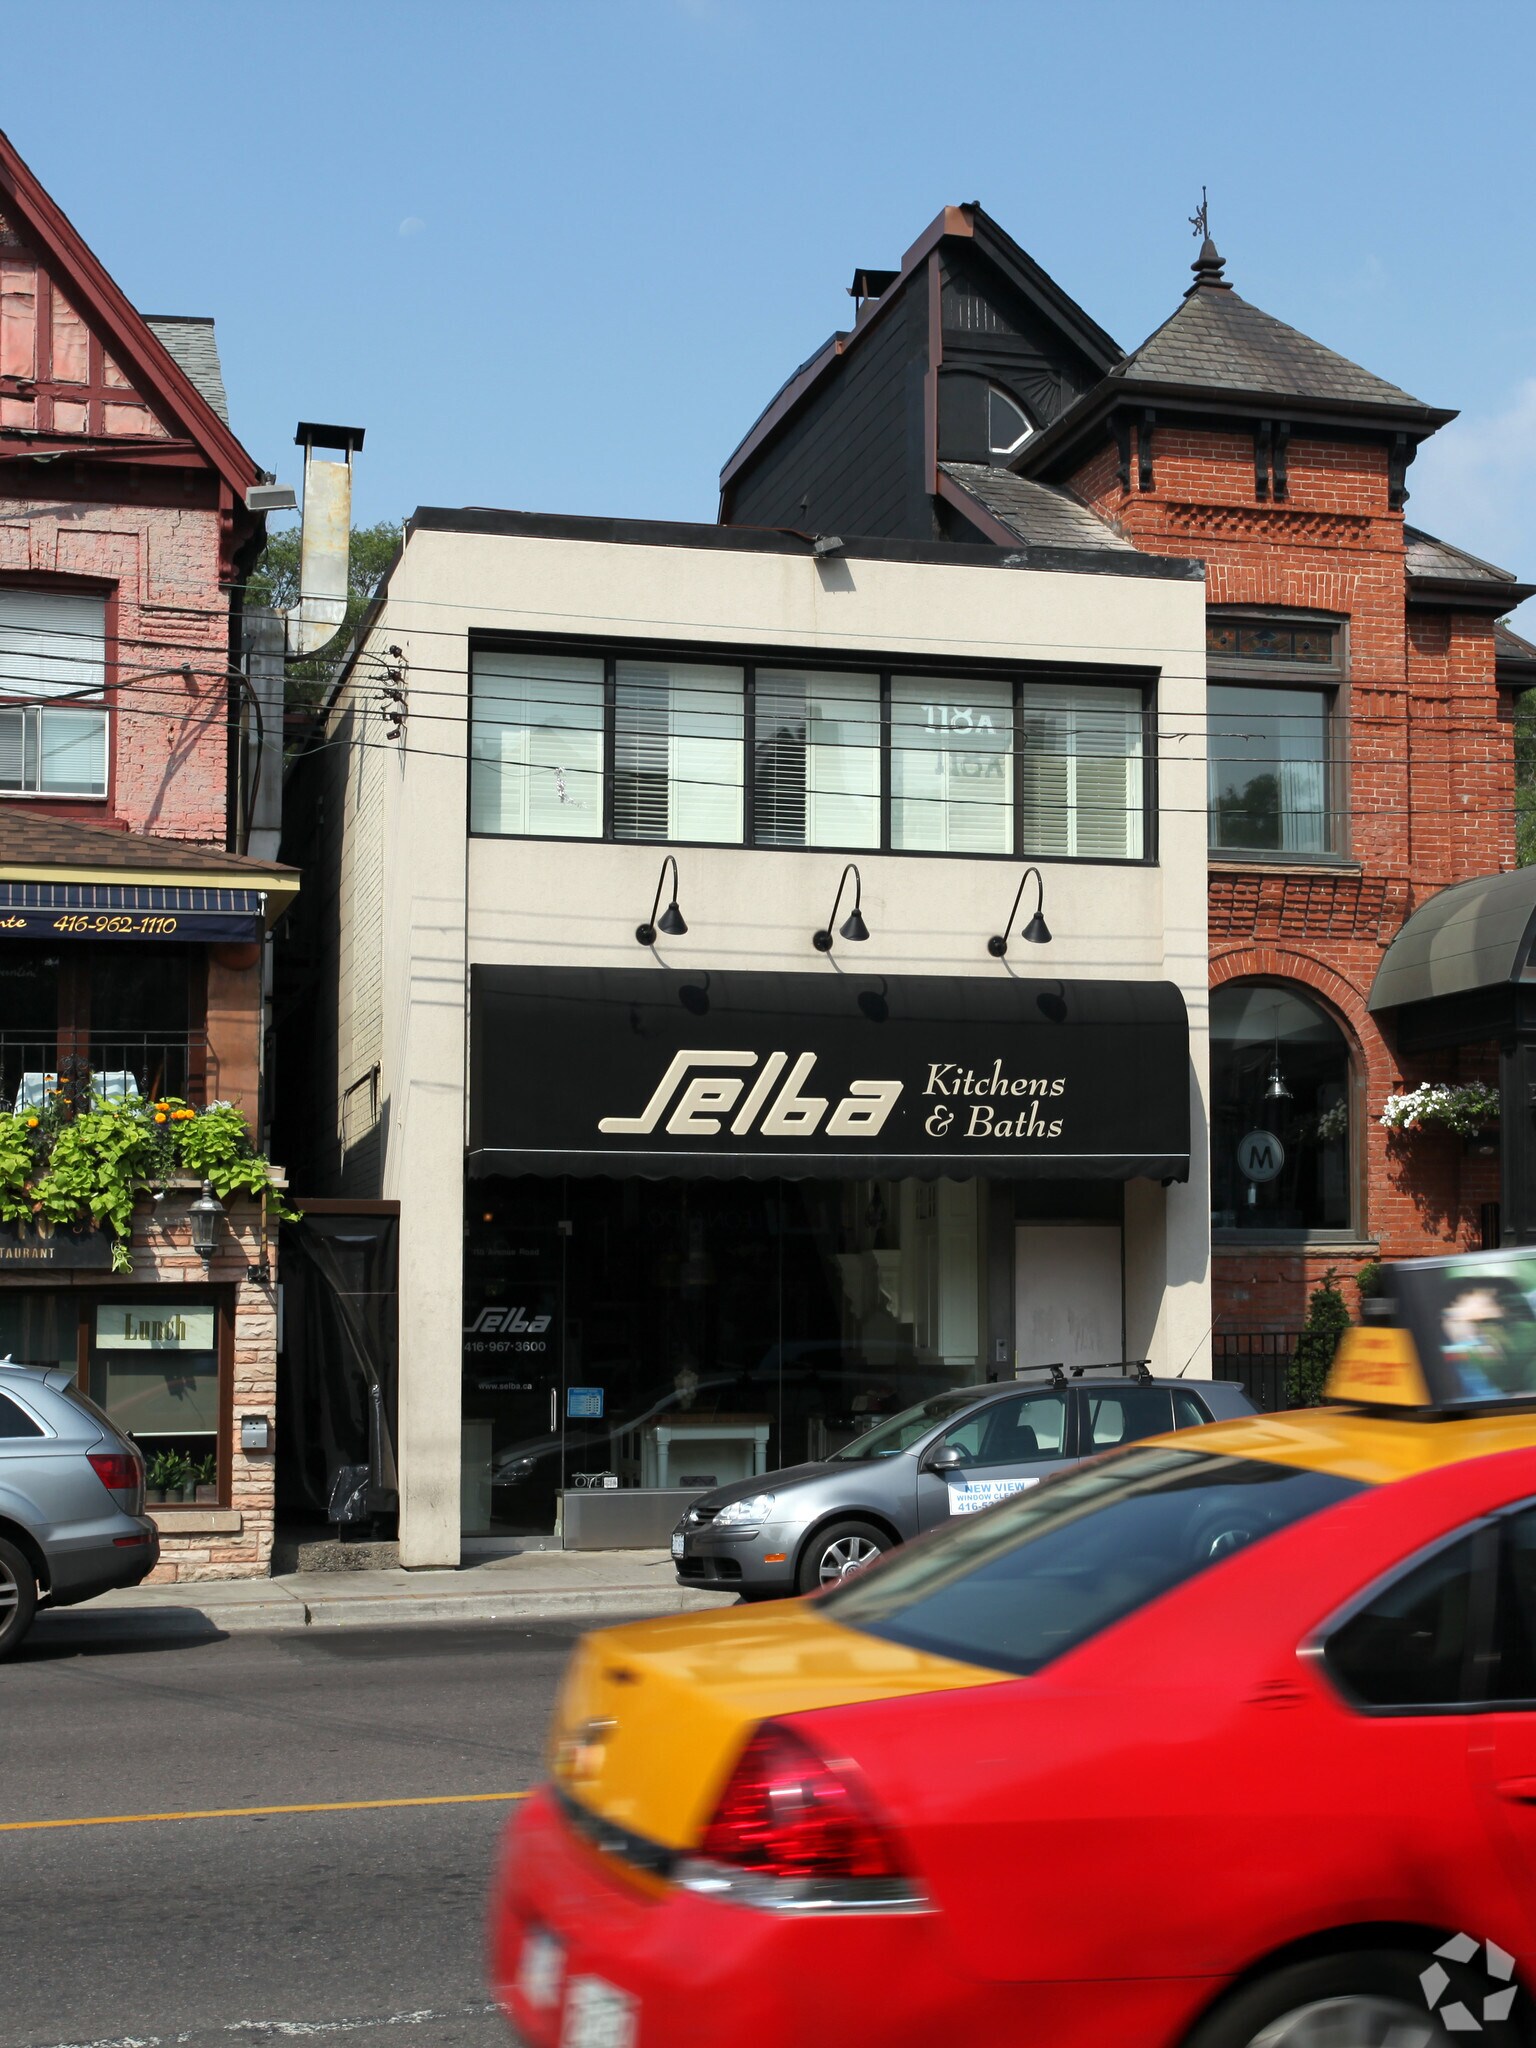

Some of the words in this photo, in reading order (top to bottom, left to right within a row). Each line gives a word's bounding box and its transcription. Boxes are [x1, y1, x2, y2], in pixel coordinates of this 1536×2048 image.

[53, 914, 177, 934] 416-962-1110
[922, 1058, 1067, 1098] Kitchens
[597, 1048, 905, 1136] Selba
[925, 1104, 956, 1138] &
[963, 1100, 1064, 1139] Baths
[1249, 1145, 1274, 1169] M
[124, 1313, 187, 1341] Lunch
[463, 1306, 552, 1333] Selba
[478, 1382, 533, 1390] www.selba.ca
[965, 1484, 992, 1493] NEW
[995, 1482, 1025, 1491] VIEW
